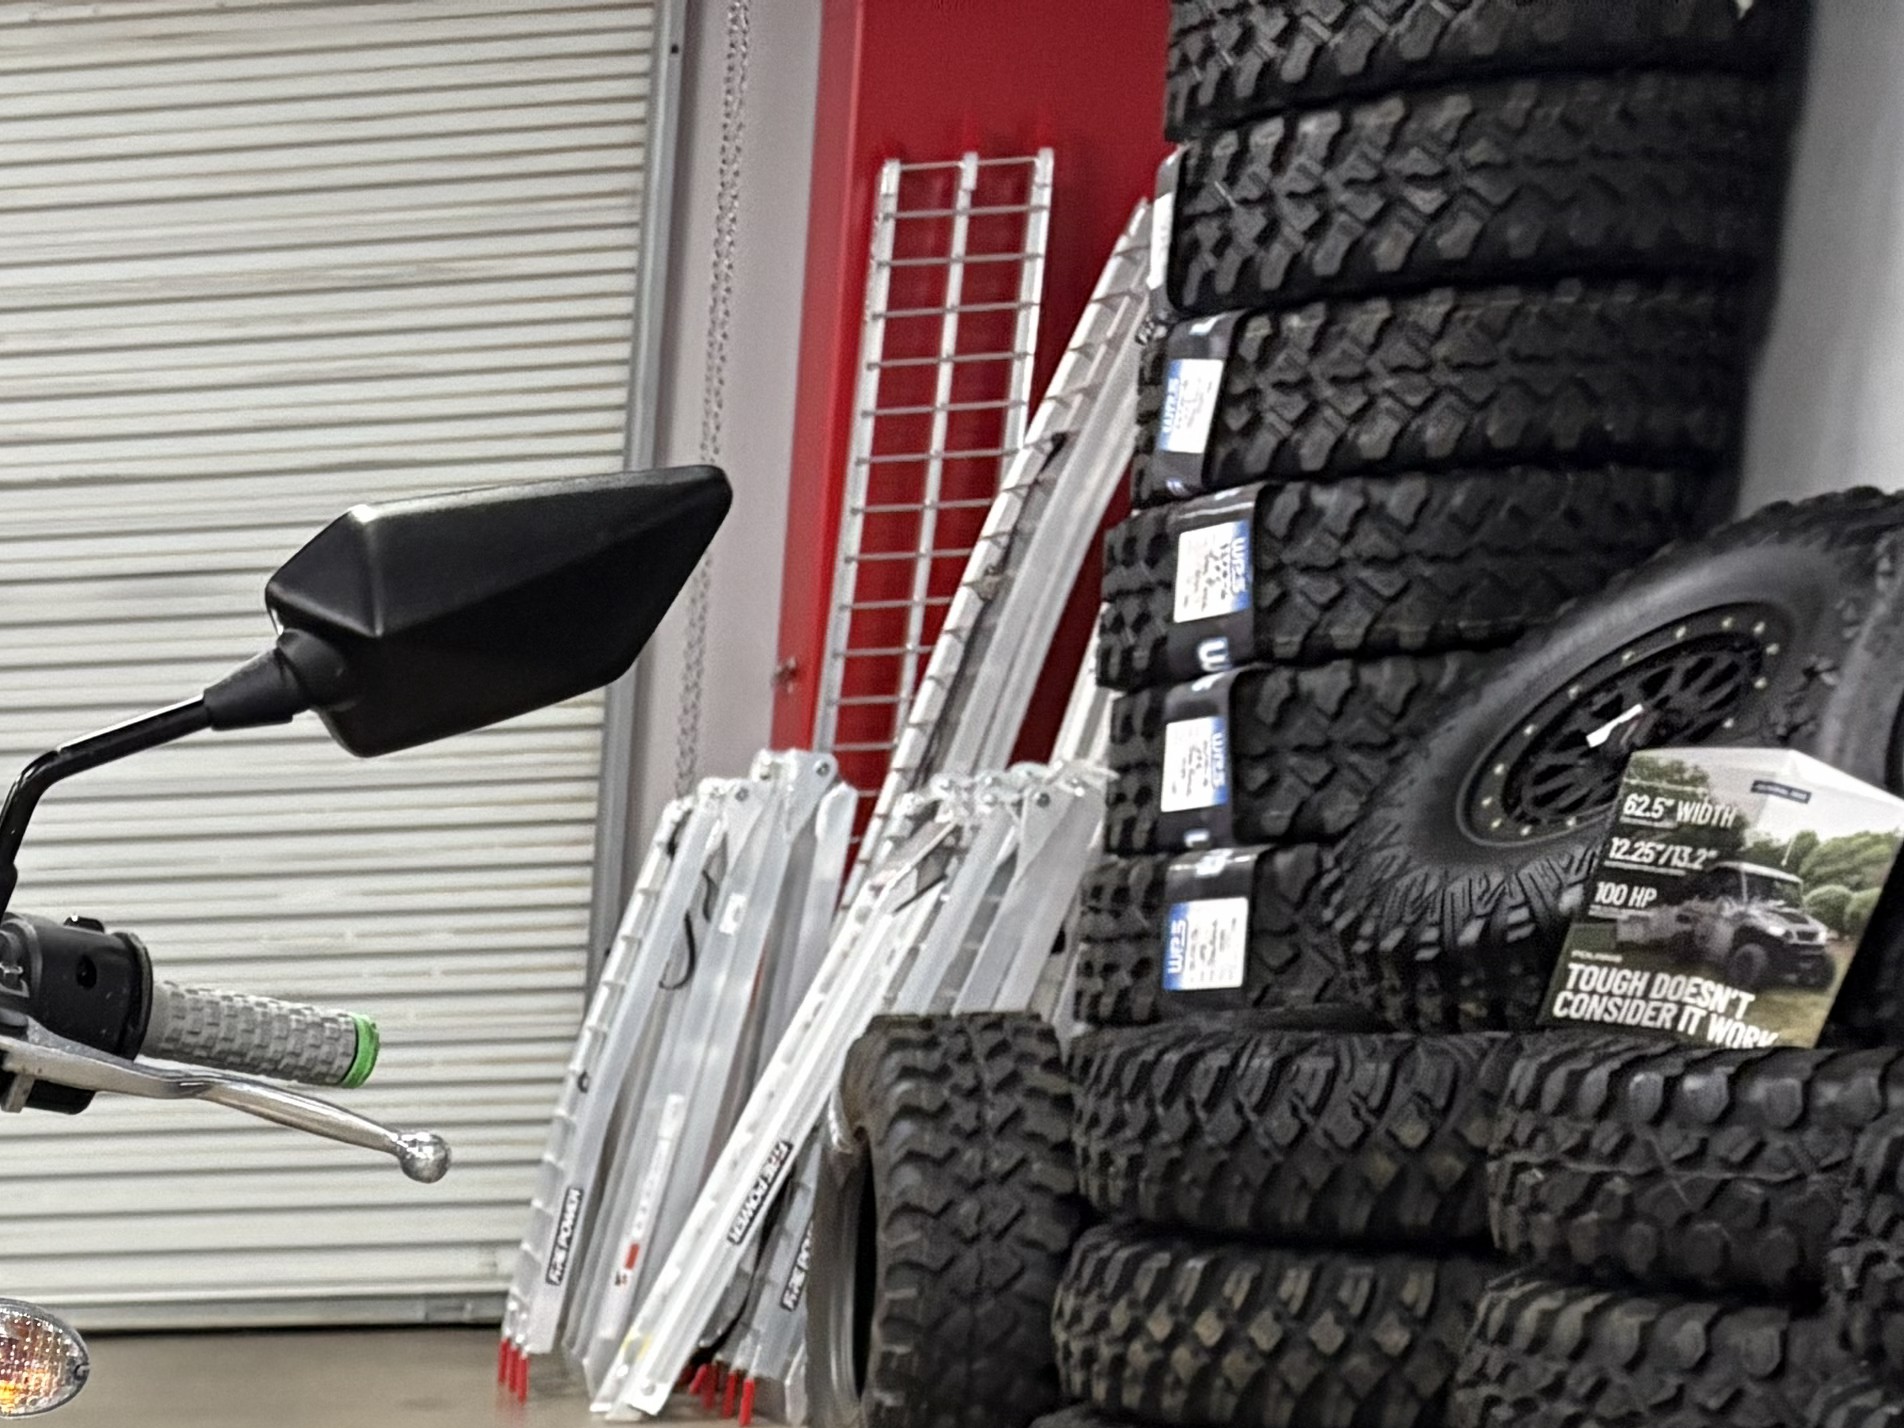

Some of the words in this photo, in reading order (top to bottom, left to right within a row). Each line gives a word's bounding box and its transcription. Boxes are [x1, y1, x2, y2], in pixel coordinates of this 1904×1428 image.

[1675, 800, 1739, 829] WIDTH
[1594, 880, 1629, 906] 100
[1627, 885, 1658, 908] HP
[1565, 962, 1649, 998] TOUGH
[1648, 972, 1757, 1021] DOESN'T
[1552, 990, 1679, 1030] CONSIDER
[1677, 1004, 1708, 1036] IT
